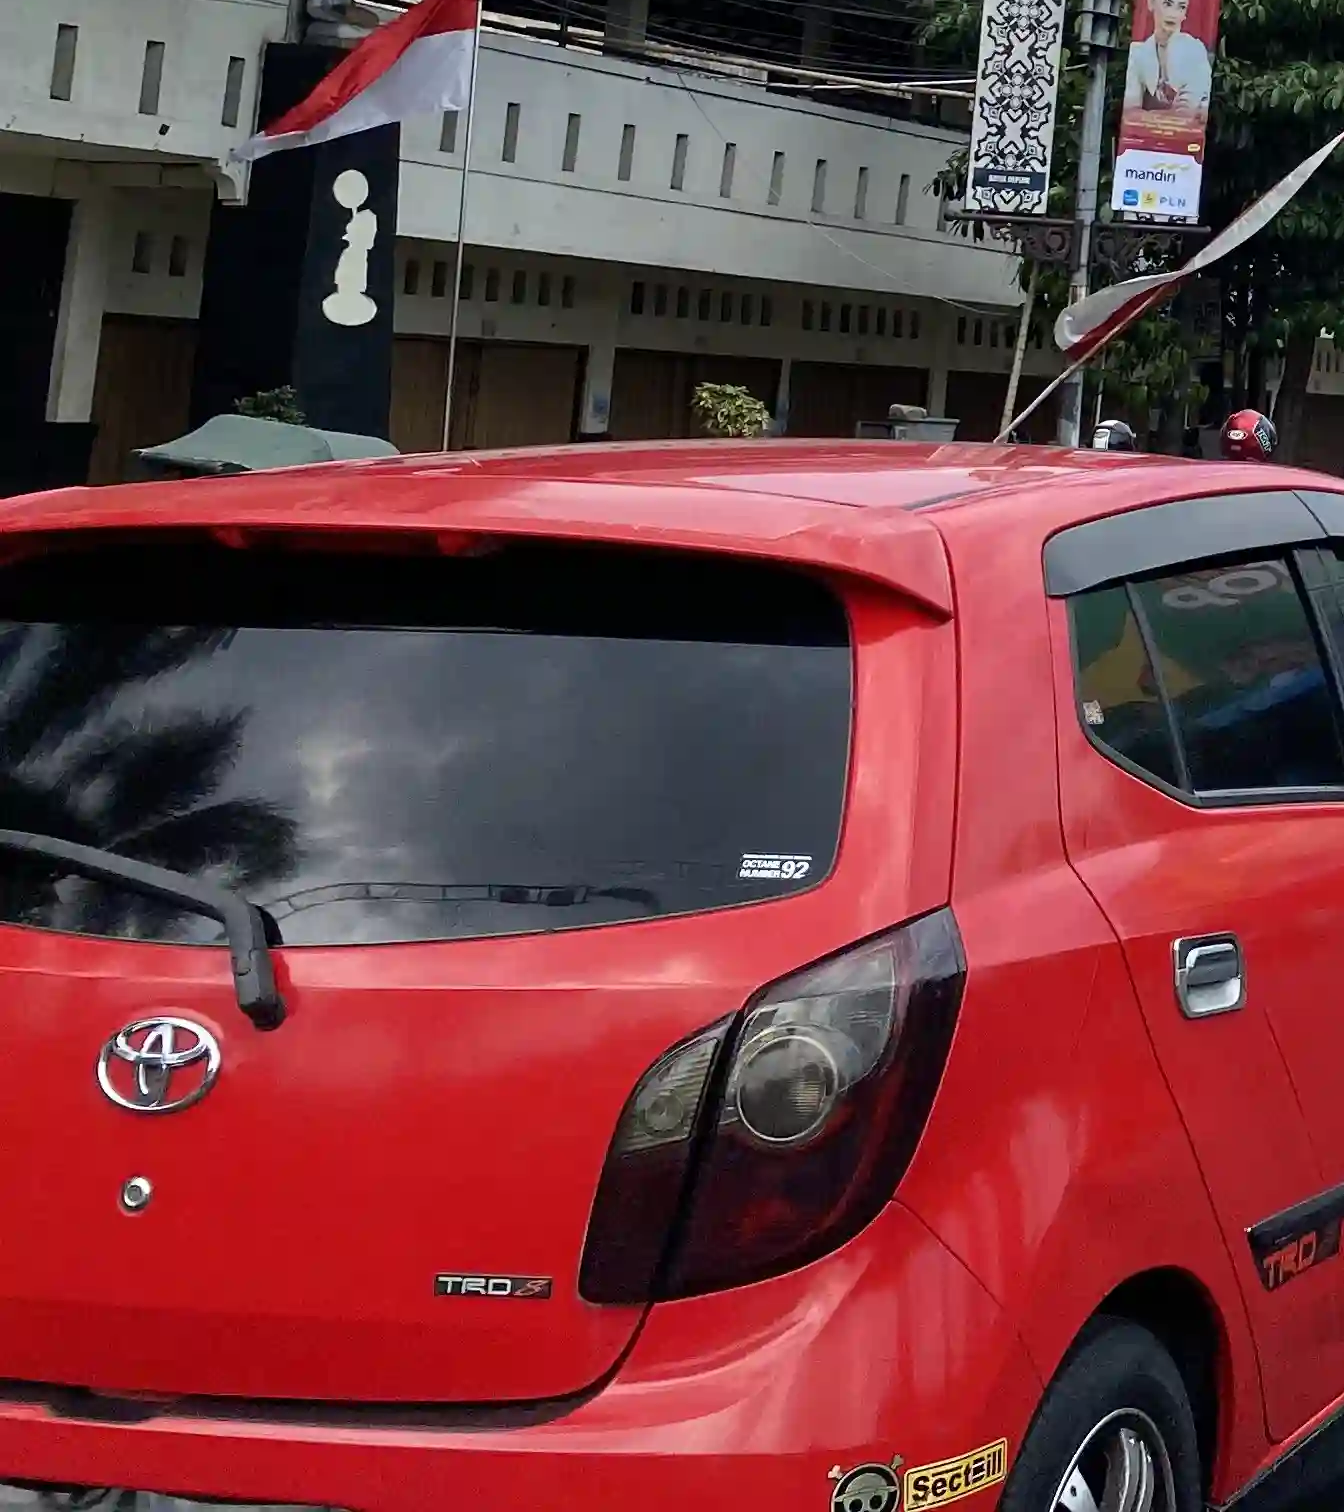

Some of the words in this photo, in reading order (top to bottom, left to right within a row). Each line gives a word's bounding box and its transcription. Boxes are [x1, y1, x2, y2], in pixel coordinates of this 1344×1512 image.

[1125, 168, 1177, 183] mandiri
[1159, 195, 1187, 208] PLN
[742, 859, 781, 869] OCTANE
[780, 860, 810, 880] 92
[1263, 1231, 1316, 1289] TRD
[437, 1276, 512, 1295] TRD
